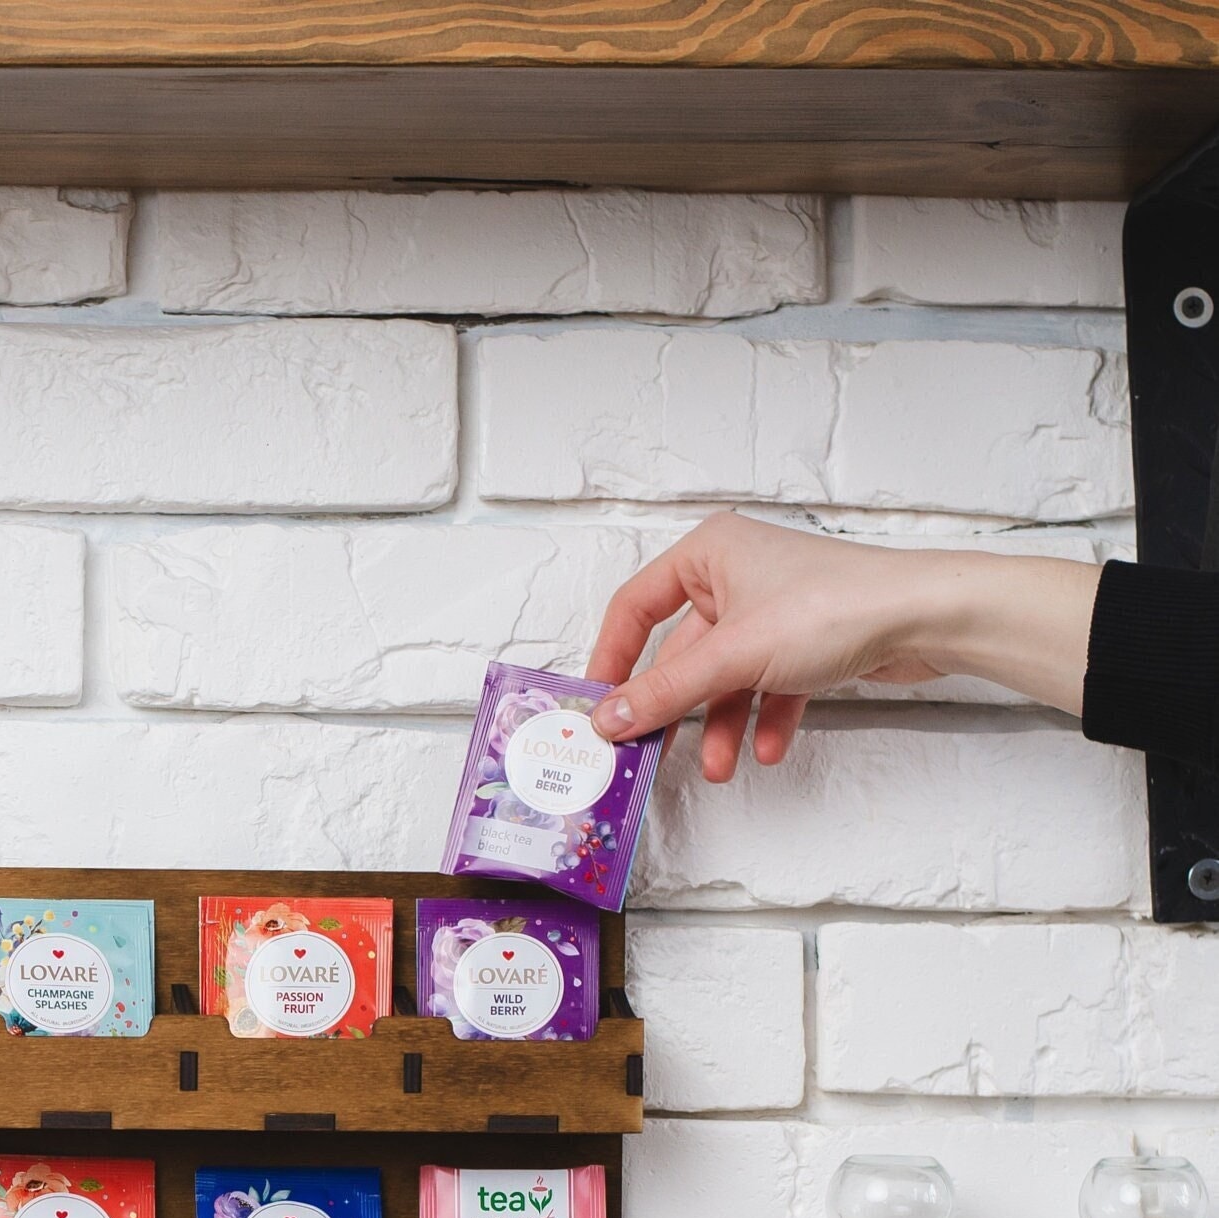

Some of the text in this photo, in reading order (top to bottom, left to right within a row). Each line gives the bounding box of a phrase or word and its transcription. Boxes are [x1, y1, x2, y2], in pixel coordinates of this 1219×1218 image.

[522, 739, 602, 769] LOVARÉ
[542, 768, 571, 783] WILD
[536, 779, 572, 795] BERRY
[480, 826, 533, 846] black tea
[477, 840, 510, 856] blend
[20, 962, 98, 983] LOVARÉ
[260, 961, 339, 983] LOVARÉ
[469, 963, 548, 985] LOVARÉ
[27, 989, 94, 999] CHAMPAGNE
[276, 992, 323, 1002] PASSION
[494, 994, 523, 1003] WILD
[35, 1000, 87, 1010] SPLASHES
[284, 1004, 315, 1014] FRUIT
[490, 1006, 526, 1015] BERRY
[477, 1187, 525, 1212] tea
